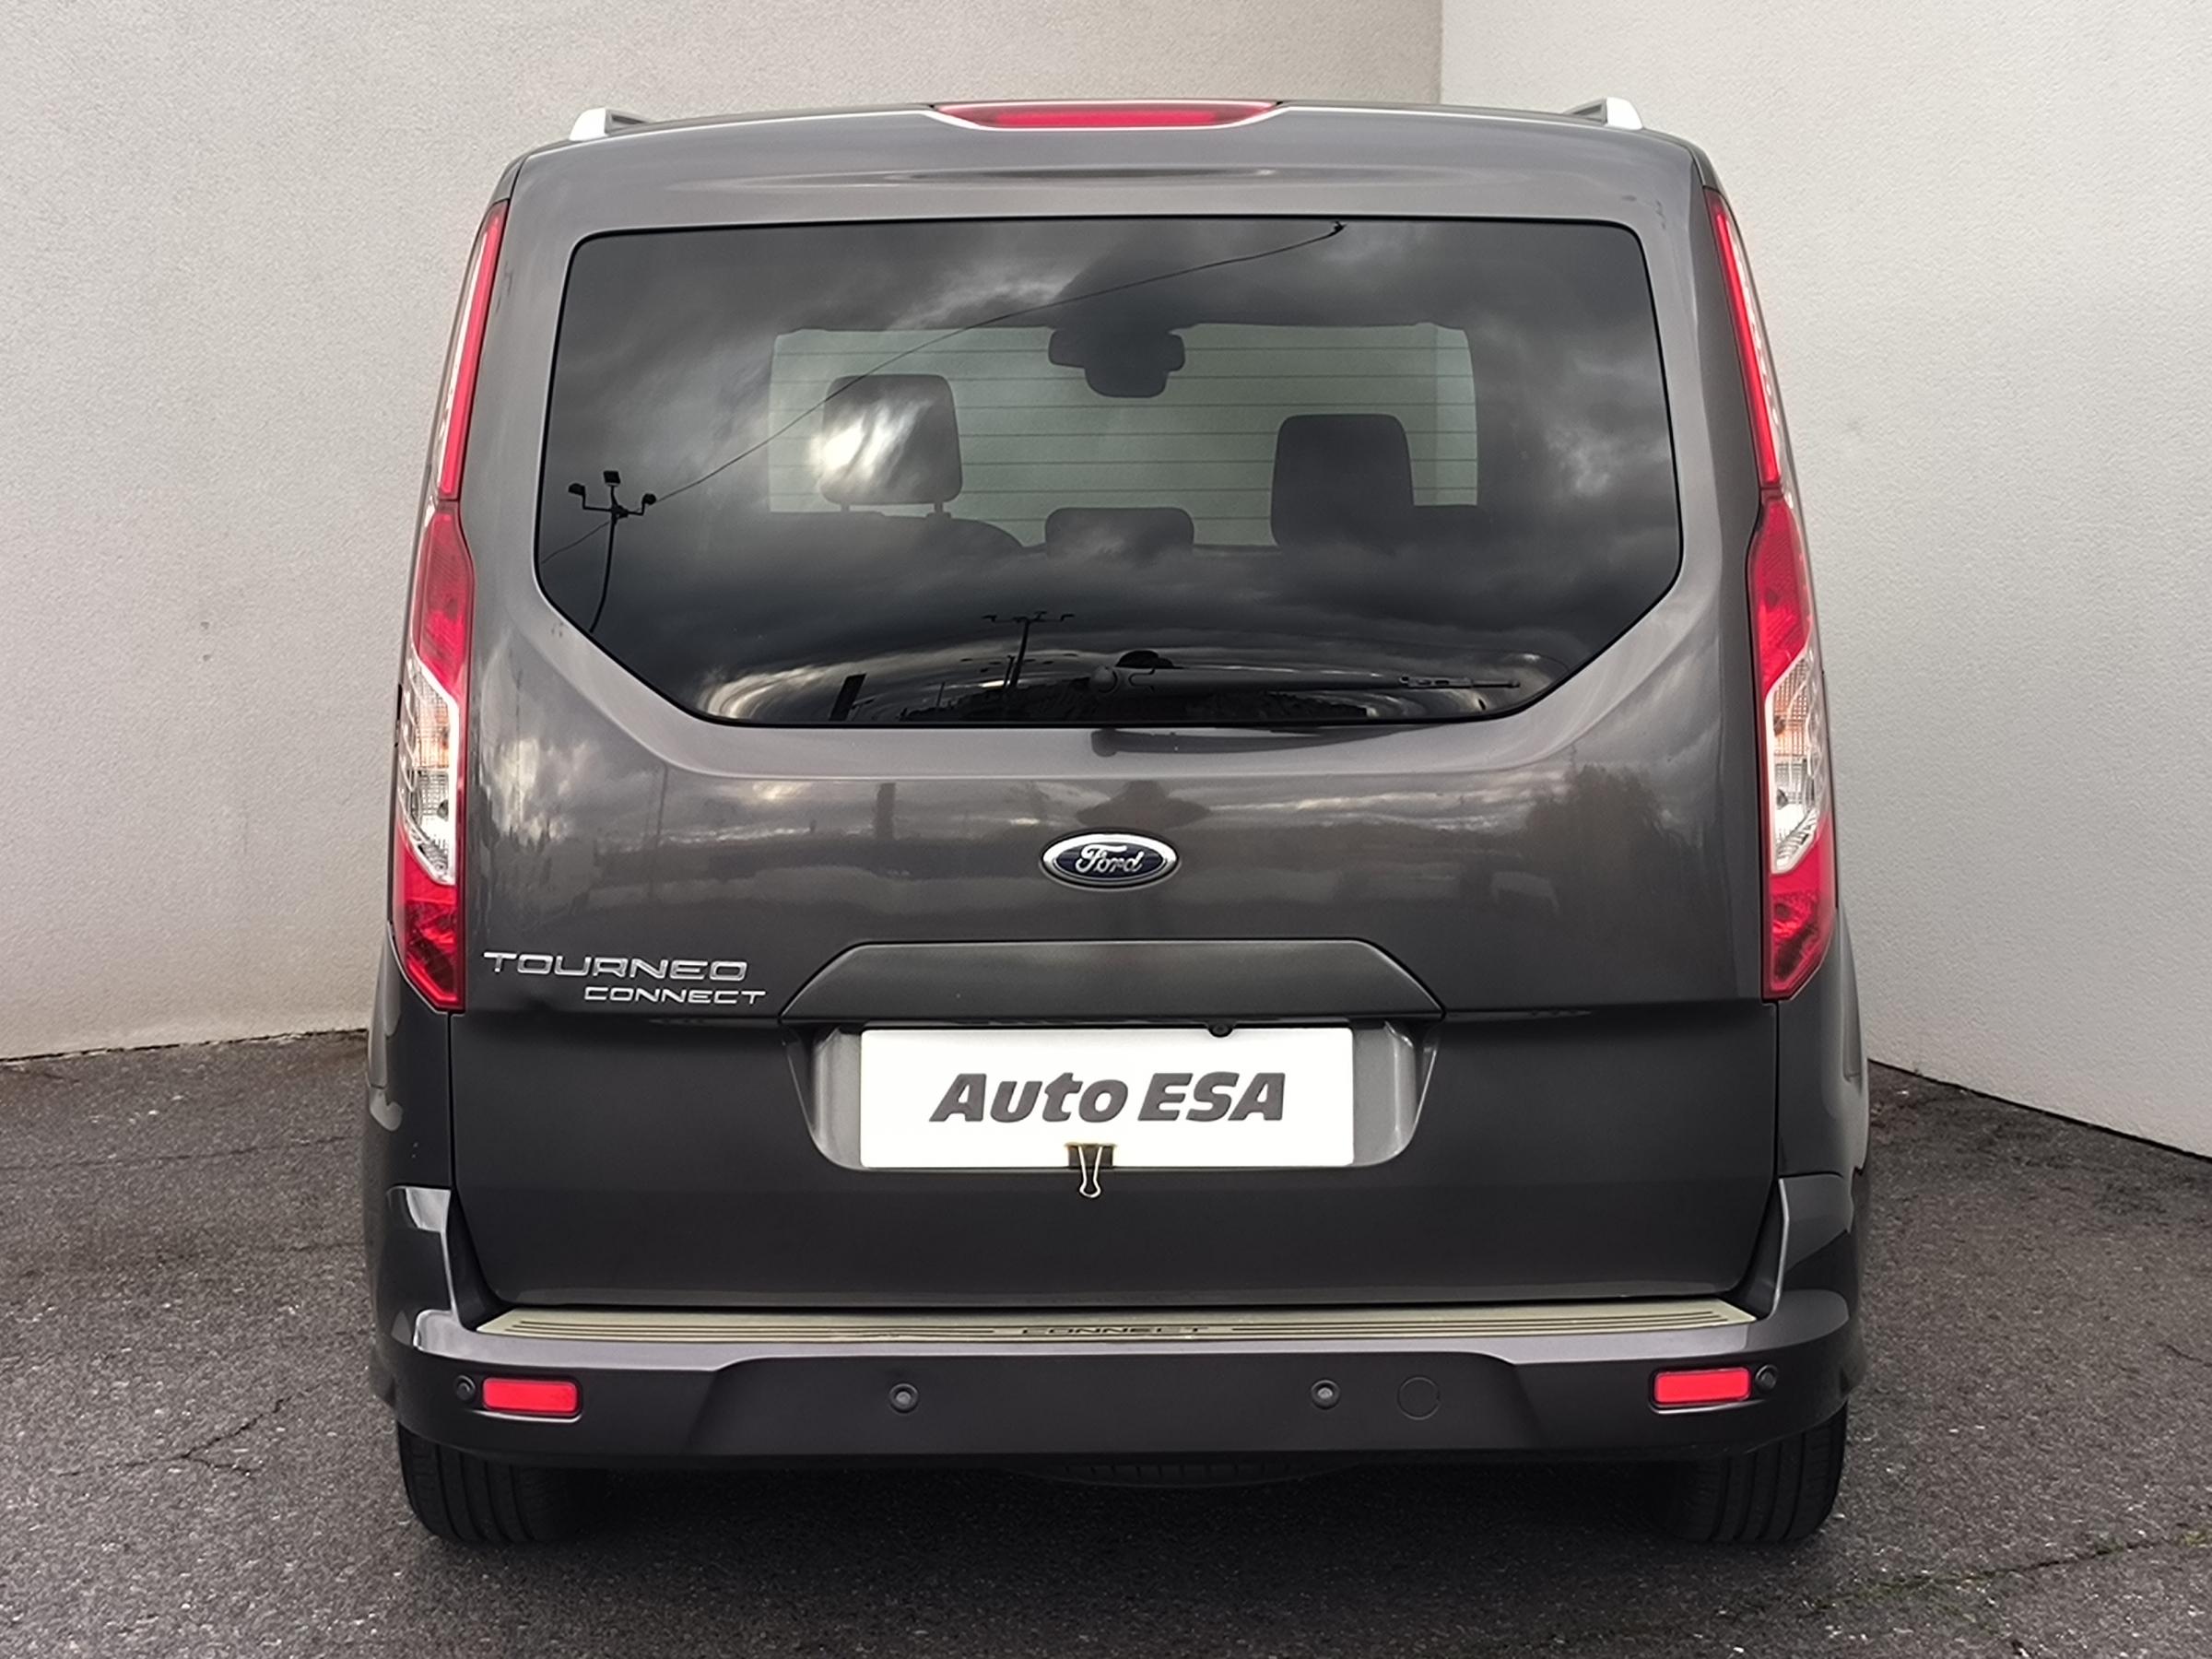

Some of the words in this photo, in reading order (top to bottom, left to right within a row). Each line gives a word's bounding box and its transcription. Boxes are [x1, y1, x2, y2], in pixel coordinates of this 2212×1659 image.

[1076, 844, 1145, 873] Ford
[483, 951, 747, 982] TOURNEO
[584, 986, 766, 1005] CONNECT
[928, 1072, 1129, 1124] Auto
[1137, 1071, 1286, 1122] ESA
